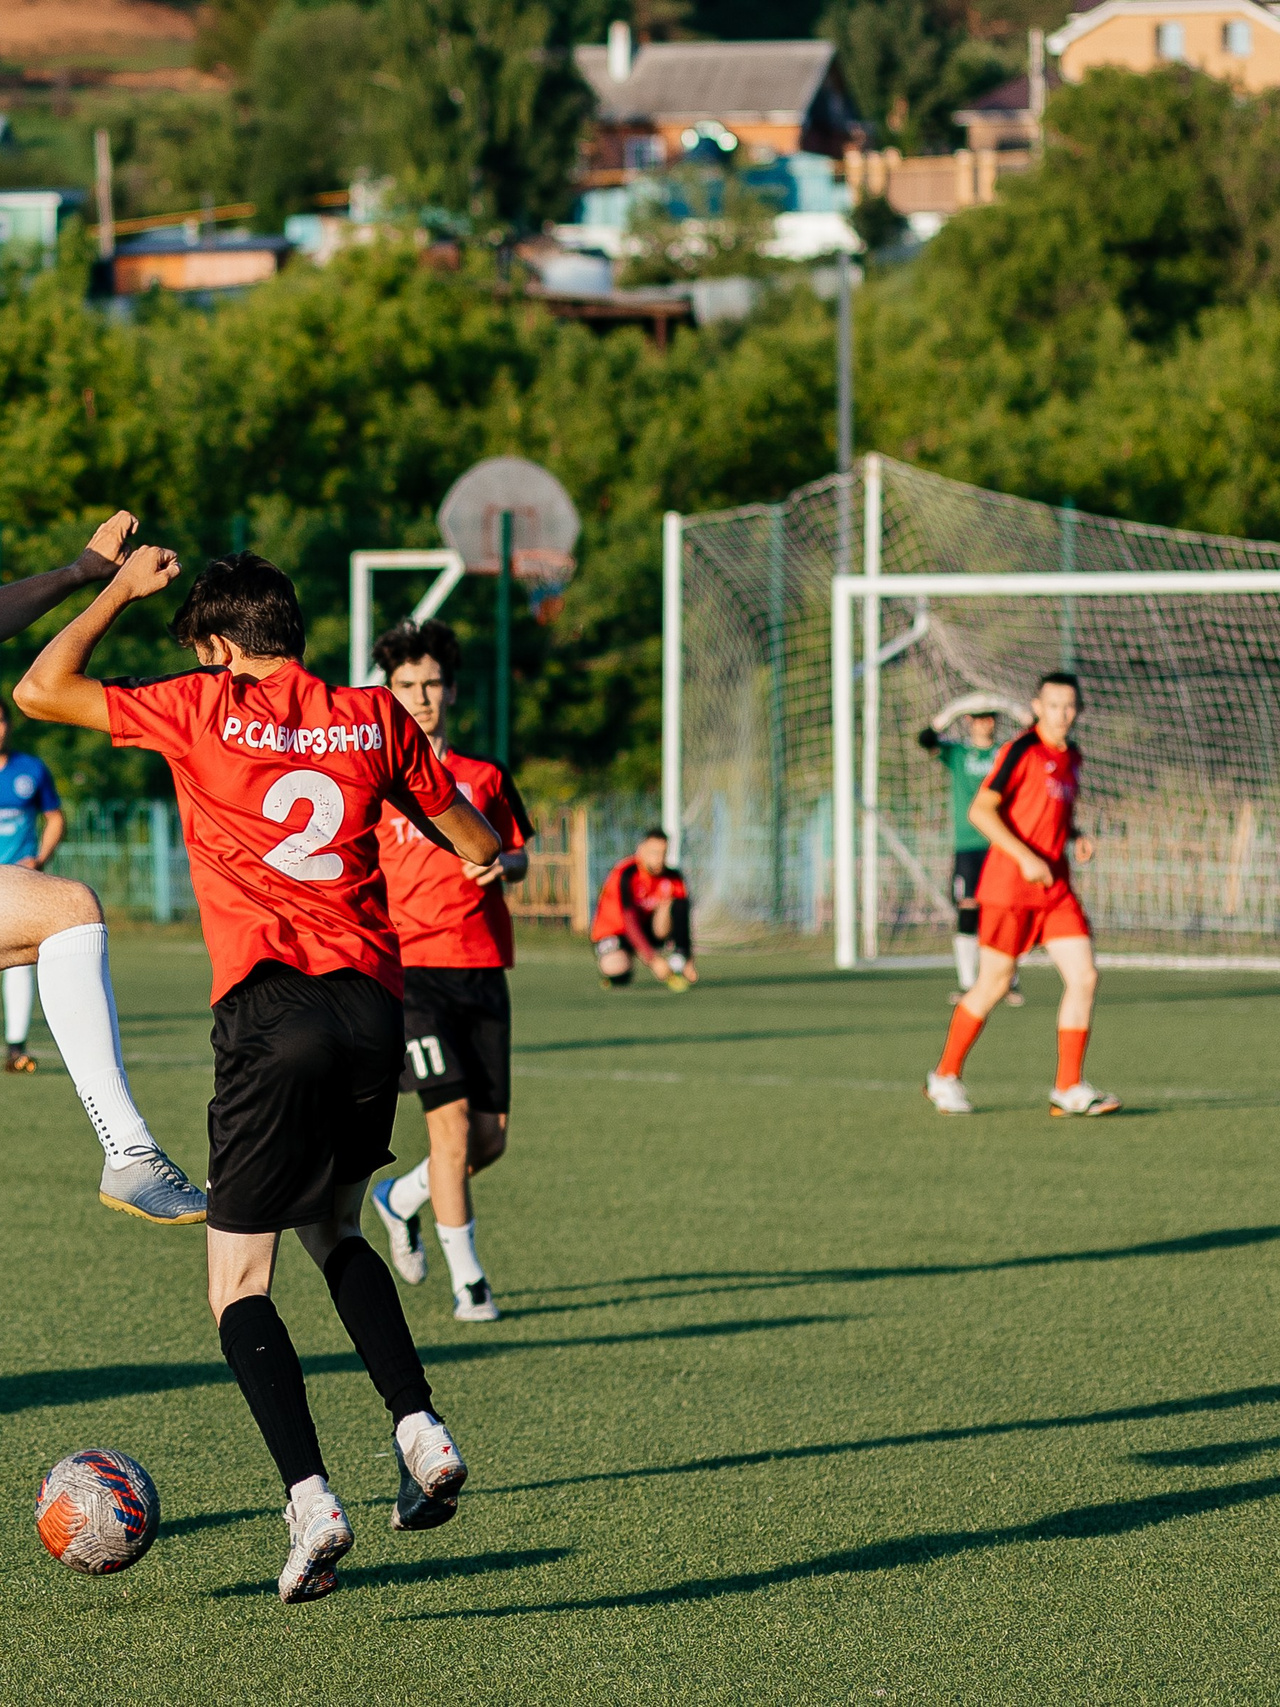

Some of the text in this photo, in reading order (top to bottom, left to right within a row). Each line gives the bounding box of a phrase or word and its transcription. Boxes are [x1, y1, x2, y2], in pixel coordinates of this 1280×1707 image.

[222, 716, 382, 755] Р.САБИРЗЯНОВ
[262, 769, 345, 881] 2
[405, 1035, 446, 1080] 11
